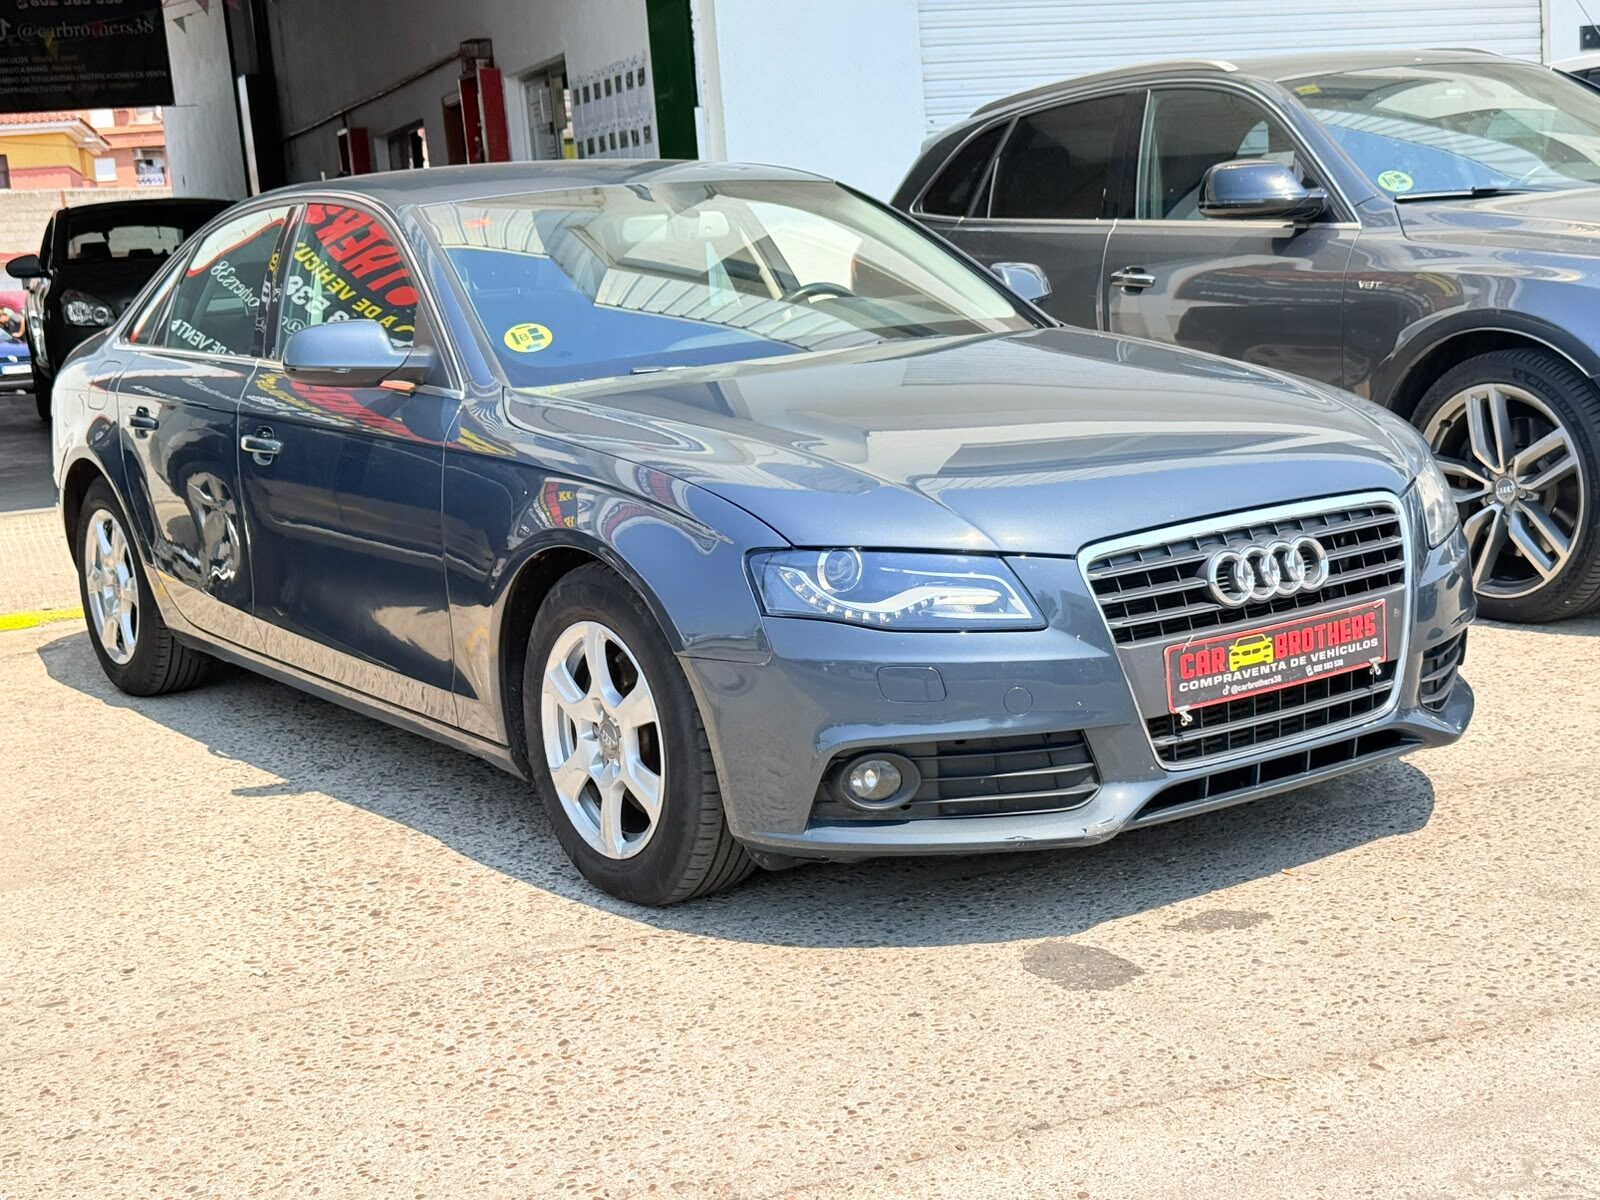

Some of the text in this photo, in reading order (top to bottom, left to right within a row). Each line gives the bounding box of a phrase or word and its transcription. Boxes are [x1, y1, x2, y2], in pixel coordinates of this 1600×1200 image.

[1179, 638, 1379, 692] COMPRAVENTA DE VEHÍCULOS
[1180, 612, 1376, 679] CAR BROTHERS
